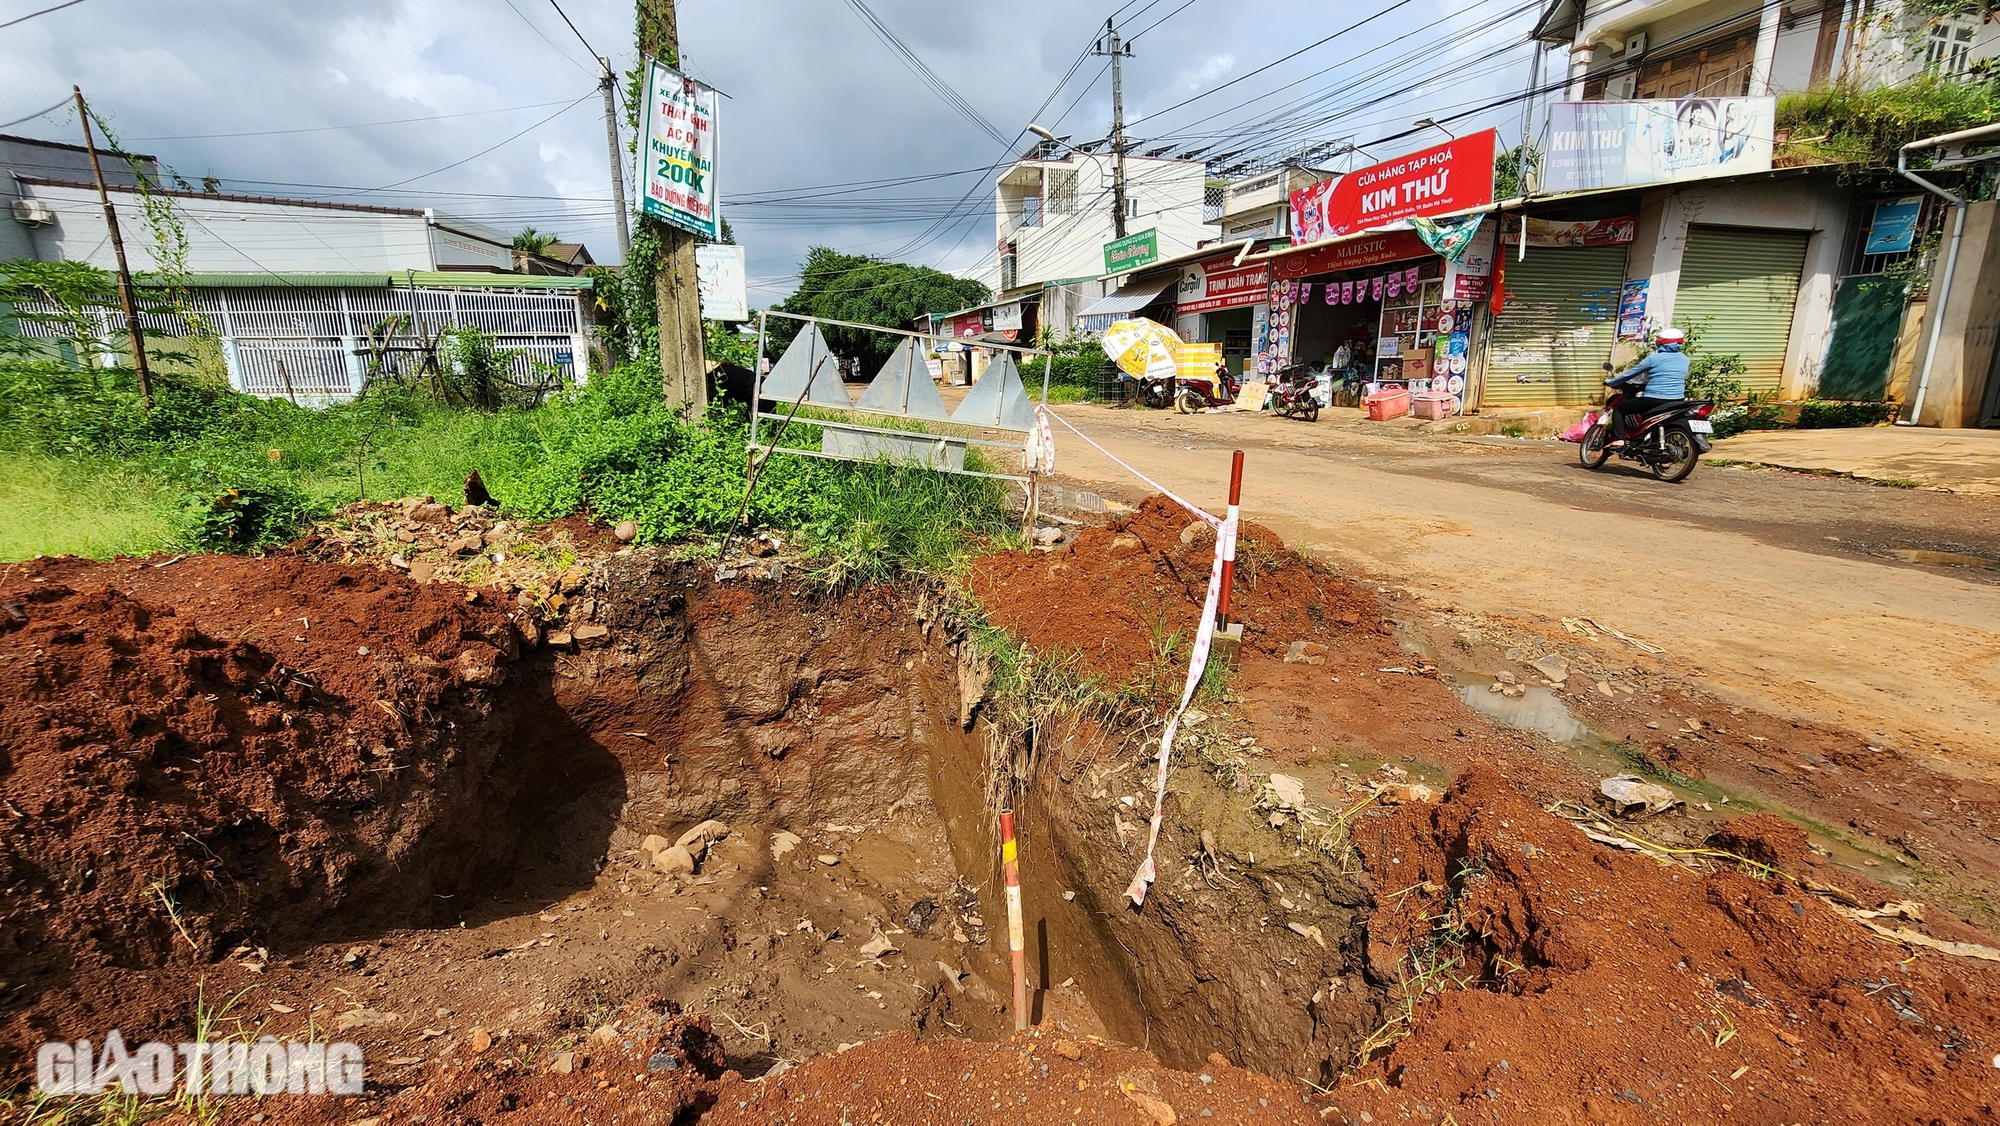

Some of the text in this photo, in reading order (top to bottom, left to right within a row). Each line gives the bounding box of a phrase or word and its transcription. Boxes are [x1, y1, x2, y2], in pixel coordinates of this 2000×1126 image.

[660, 88, 671, 98] XE
[693, 102, 710, 116] AKA
[661, 102, 707, 132] THAY BNH
[667, 122, 682, 141] ẮC
[1552, 126, 1626, 151] KIM THỨ
[657, 158, 704, 194] 200K
[1358, 147, 1453, 187] CỬA HÀNG TẠP HOÁ
[651, 180, 663, 199] BẢO
[1361, 167, 1450, 214] KIM THỨ
[1304, 207, 1317, 221] OMO
[1392, 208, 1405, 216] Khánh
[1180, 276, 1203, 294] Cargill
[1209, 271, 1268, 294] TRỊNH XUÂN TRANG
